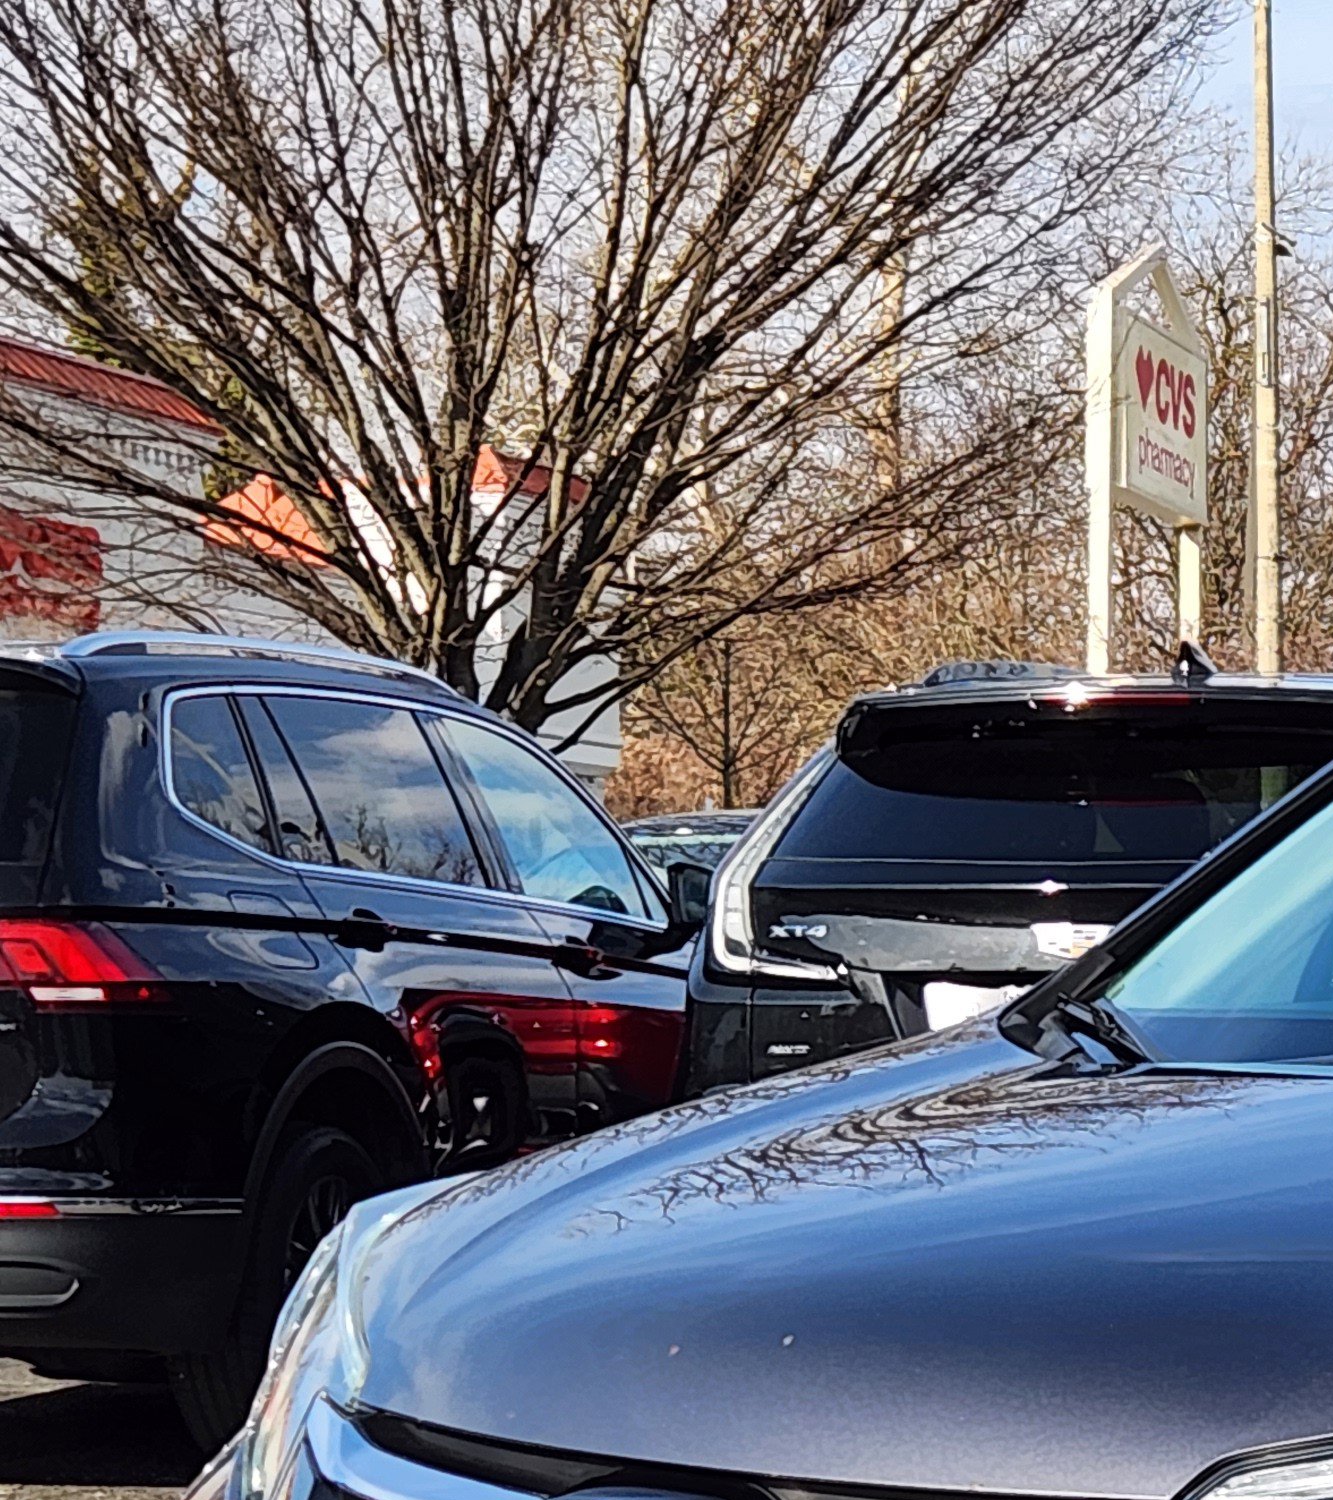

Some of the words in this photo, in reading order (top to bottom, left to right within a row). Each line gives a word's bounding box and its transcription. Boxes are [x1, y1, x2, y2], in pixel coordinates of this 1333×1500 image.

[1155, 358, 1196, 439] CVS
[1137, 427, 1196, 500] pharmacy
[768, 925, 827, 938] XT4
